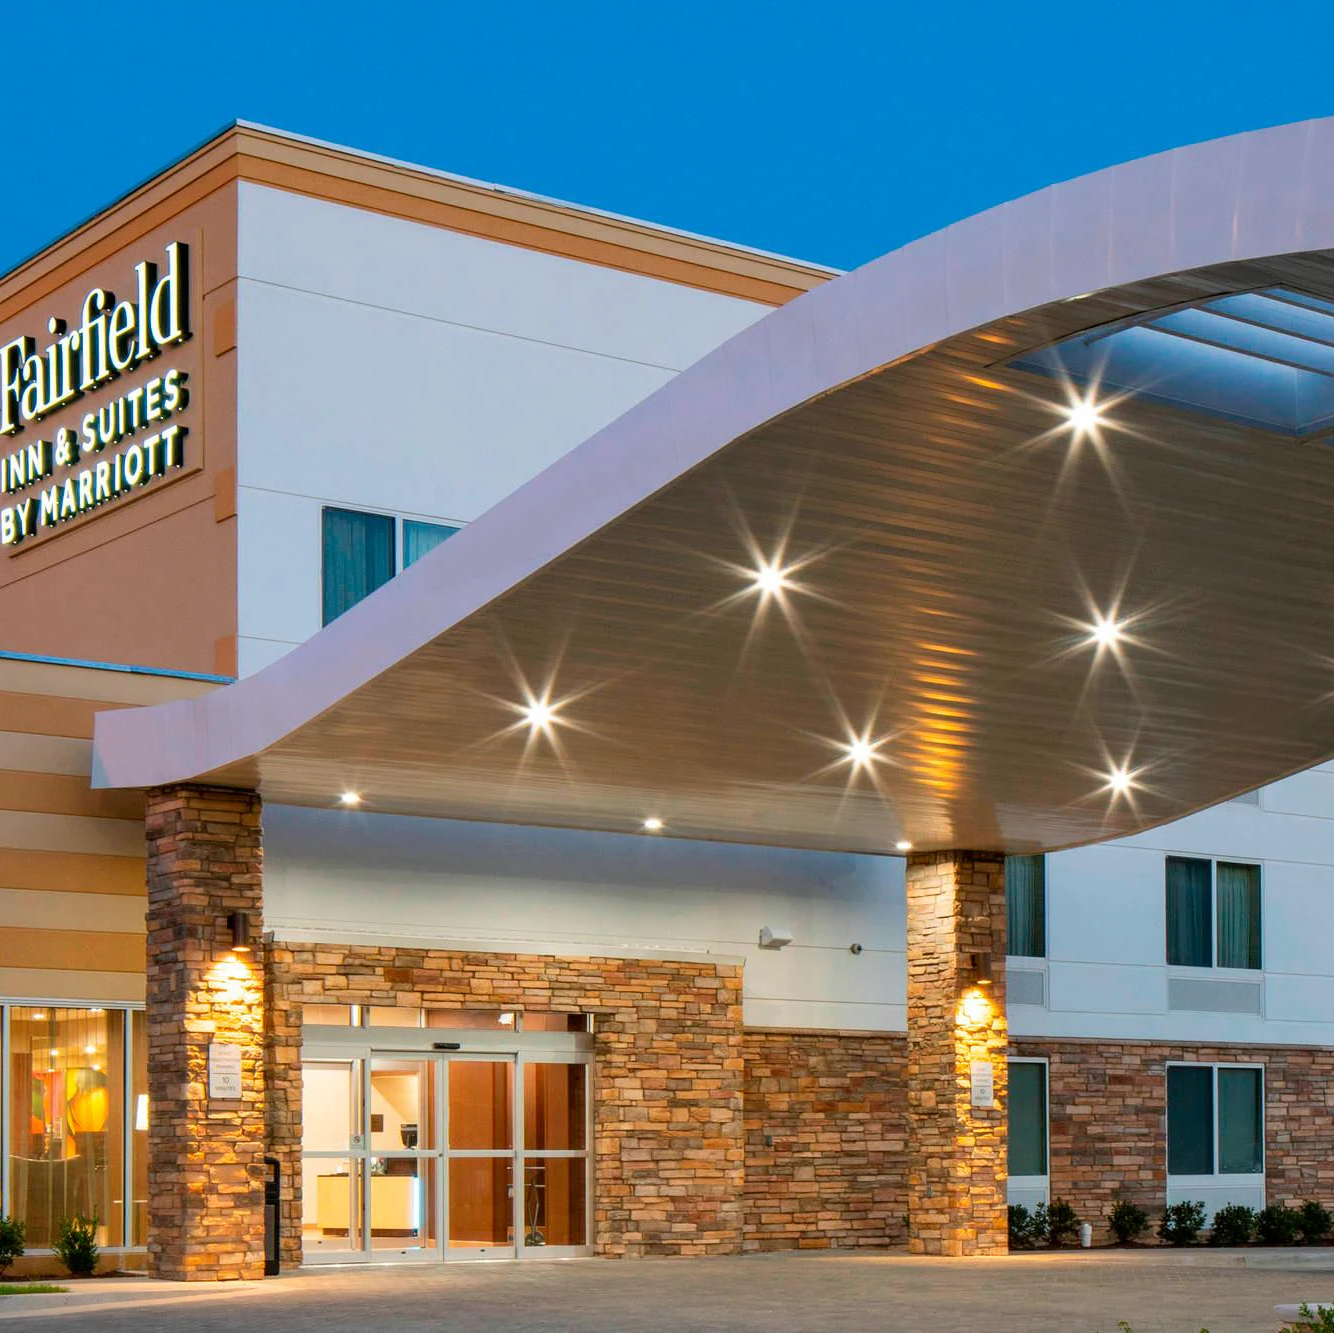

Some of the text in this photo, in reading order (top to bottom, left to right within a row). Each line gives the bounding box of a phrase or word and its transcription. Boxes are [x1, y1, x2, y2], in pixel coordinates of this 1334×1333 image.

[1, 369, 182, 493] INN & SUITES
[1, 424, 182, 544] BY MARRIOTT
